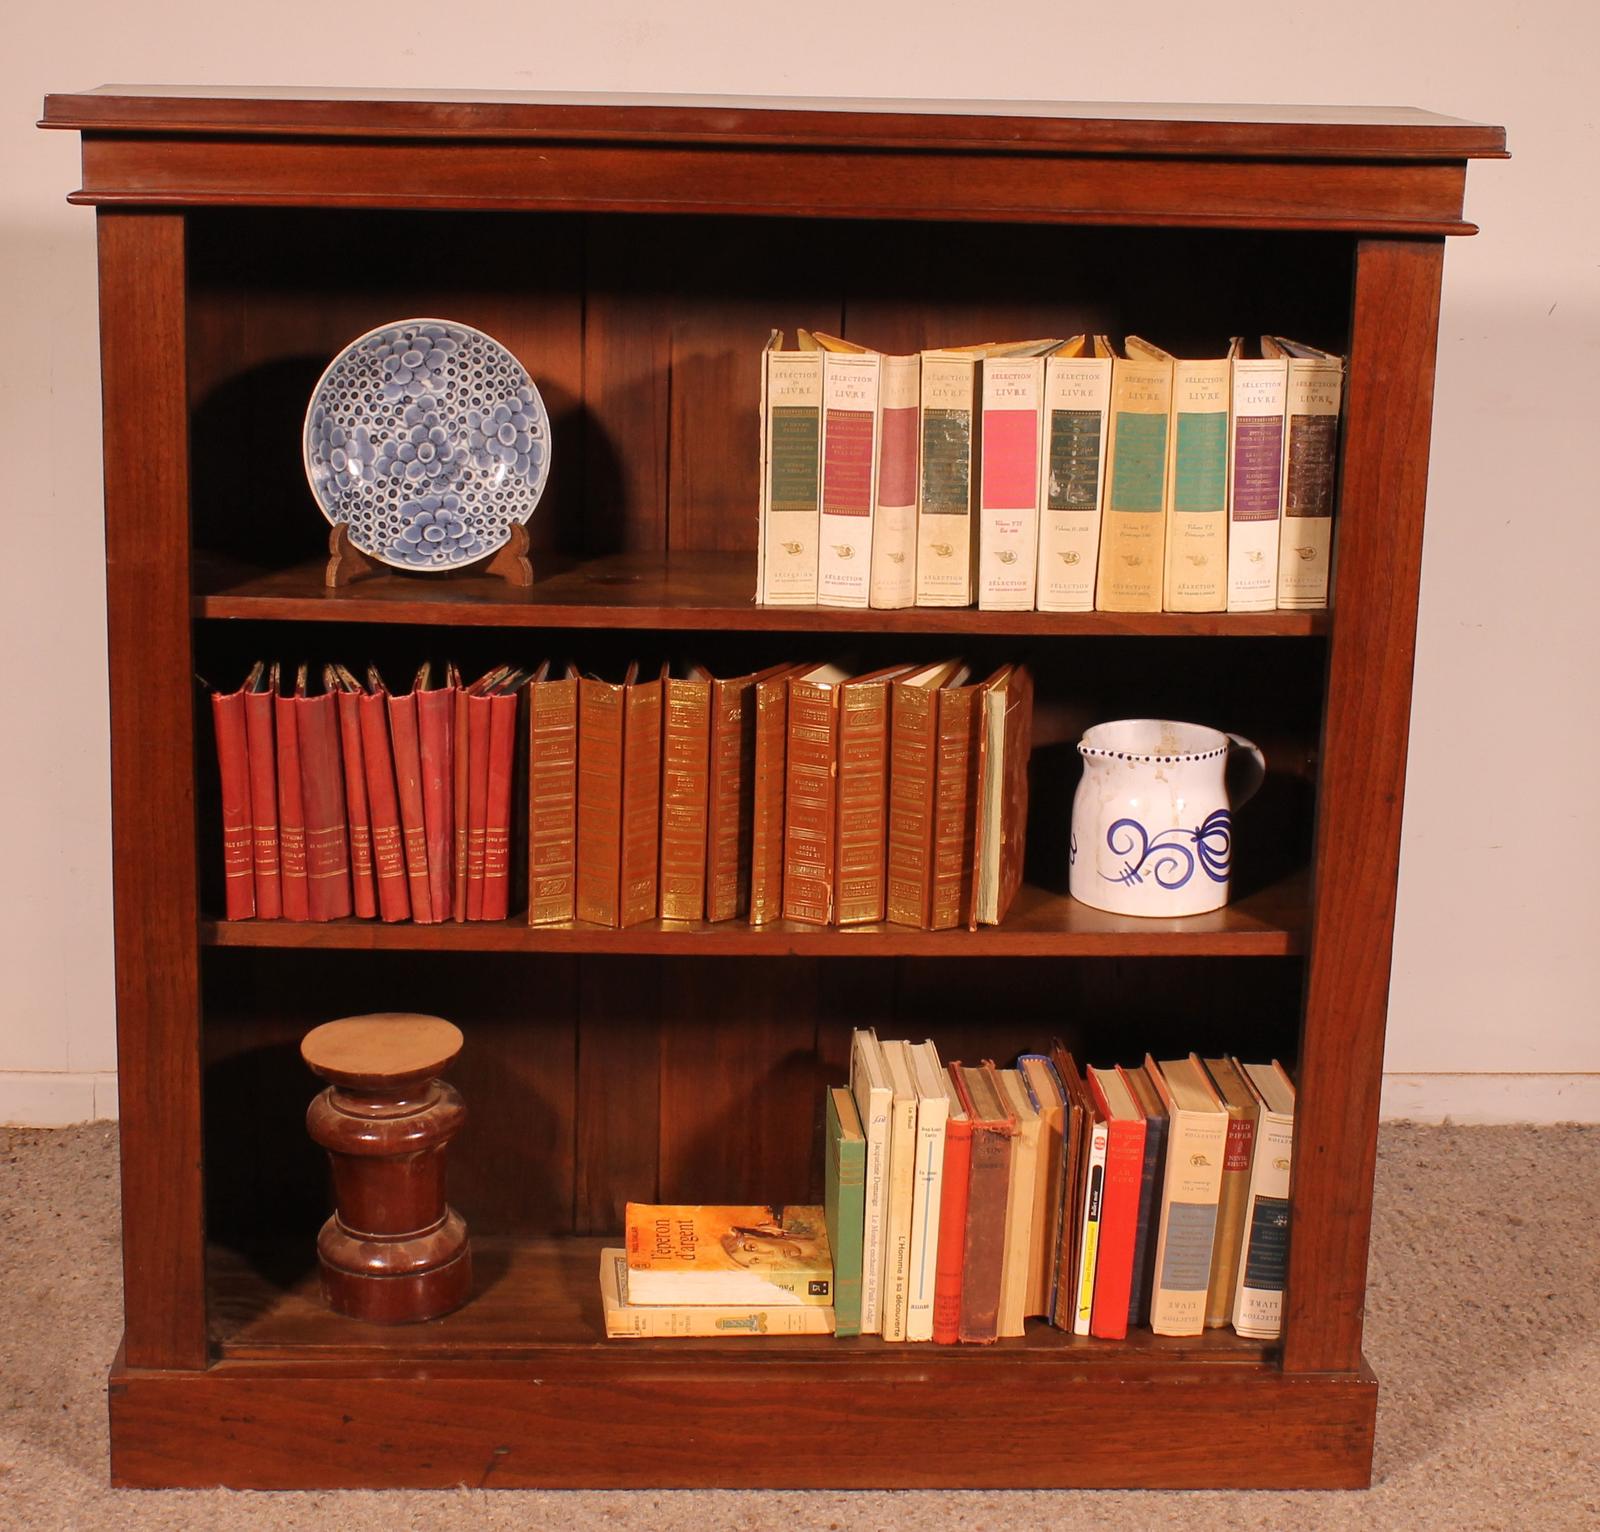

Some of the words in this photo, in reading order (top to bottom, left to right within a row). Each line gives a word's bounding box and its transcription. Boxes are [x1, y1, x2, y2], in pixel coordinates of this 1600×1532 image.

[835, 390, 867, 399] LIVRE
[995, 388, 1027, 396] LIVRE
[1061, 389, 1094, 397] LIVRE
[1189, 391, 1220, 400] LIVRE
[1247, 396, 1276, 404] LIVRE
[873, 1141, 882, 1176] Jacqueline
[674, 1219, 699, 1261] d'argent
[897, 1236, 906, 1274] L'Homme
[896, 1283, 902, 1292] sa
[1250, 1299, 1279, 1309] LIVRE
[894, 1293, 903, 1337] découverte
